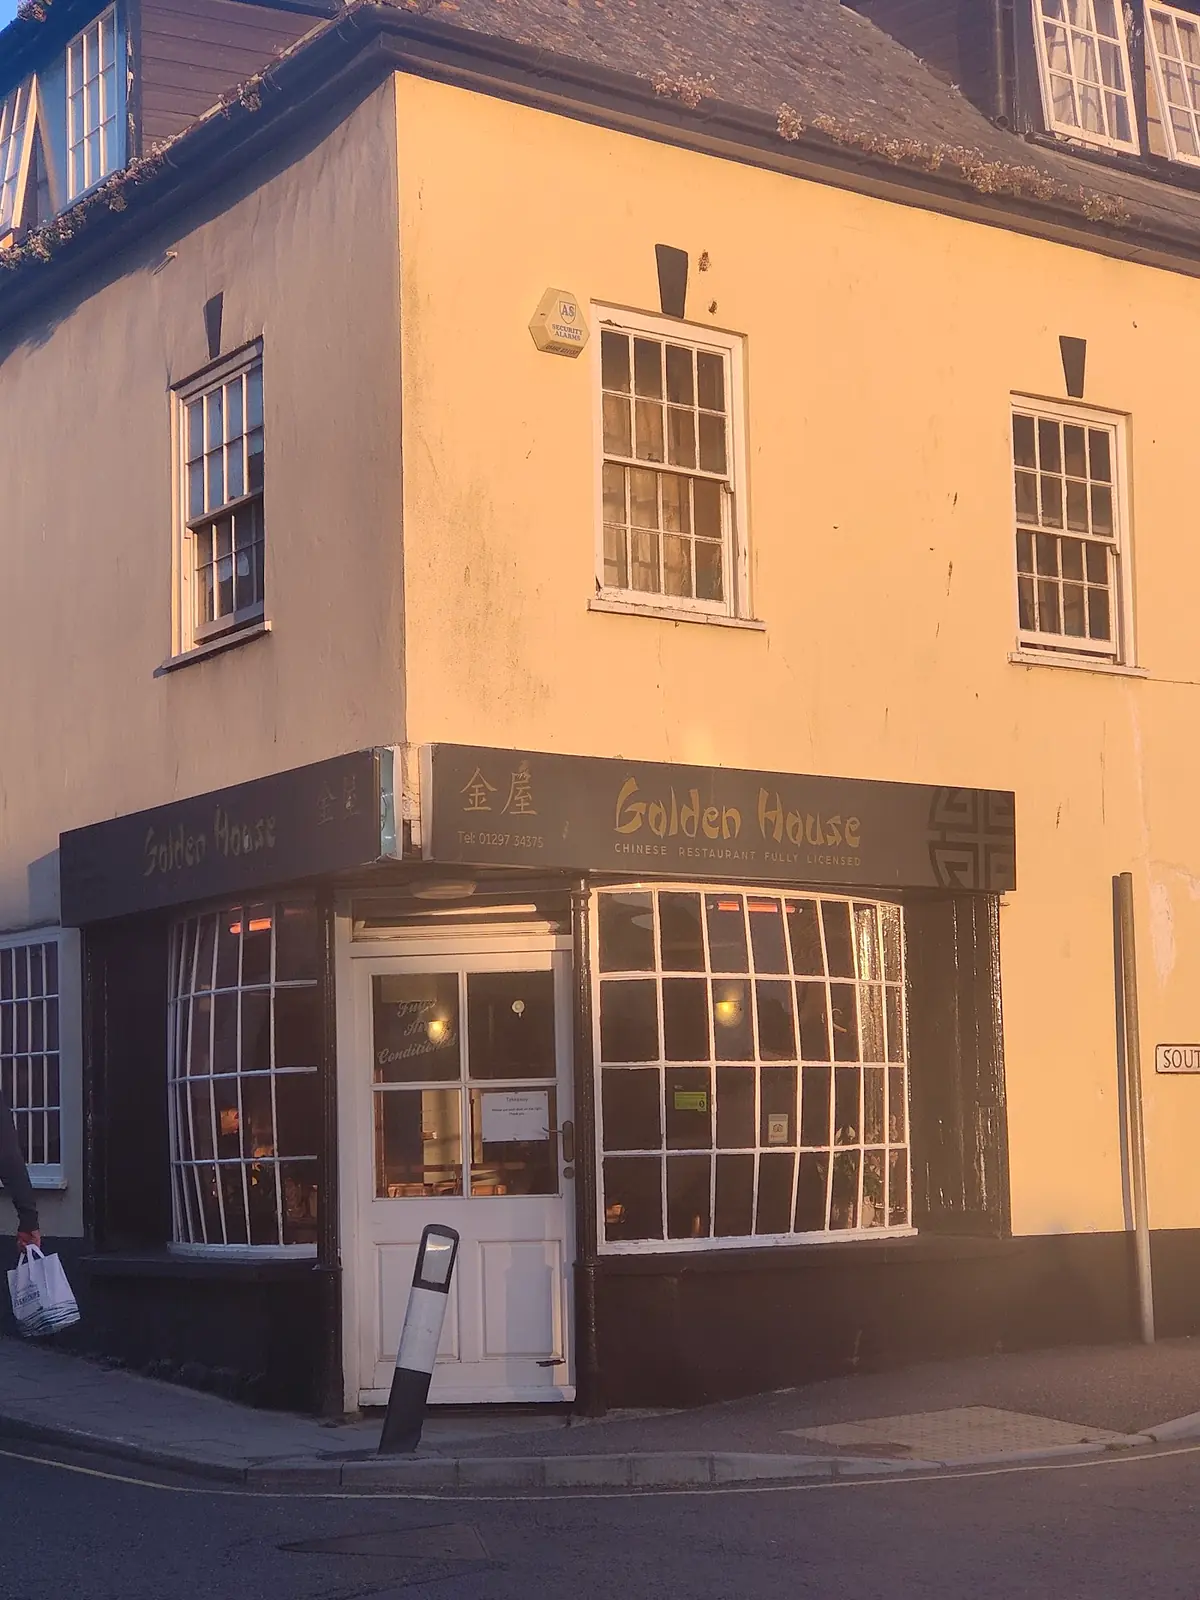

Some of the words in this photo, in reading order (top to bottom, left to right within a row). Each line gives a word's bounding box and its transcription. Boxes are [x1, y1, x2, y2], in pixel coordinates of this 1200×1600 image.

[562, 304, 575, 317] AS
[552, 324, 583, 336] SECURITY
[555, 331, 581, 341] ALARMS
[614, 776, 742, 840] Golden
[757, 787, 861, 848] House
[142, 825, 206, 877] Golden
[213, 806, 277, 858] House
[457, 830, 476, 844] Tel:
[479, 832, 510, 846] 01297
[513, 835, 544, 848] 34375
[614, 843, 668, 856] CHINESE
[678, 847, 756, 861] RESTAURANT
[764, 852, 799, 864] FULLY
[806, 855, 862, 867] LICENSED
[1163, 1048, 1200, 1069] SOUT
